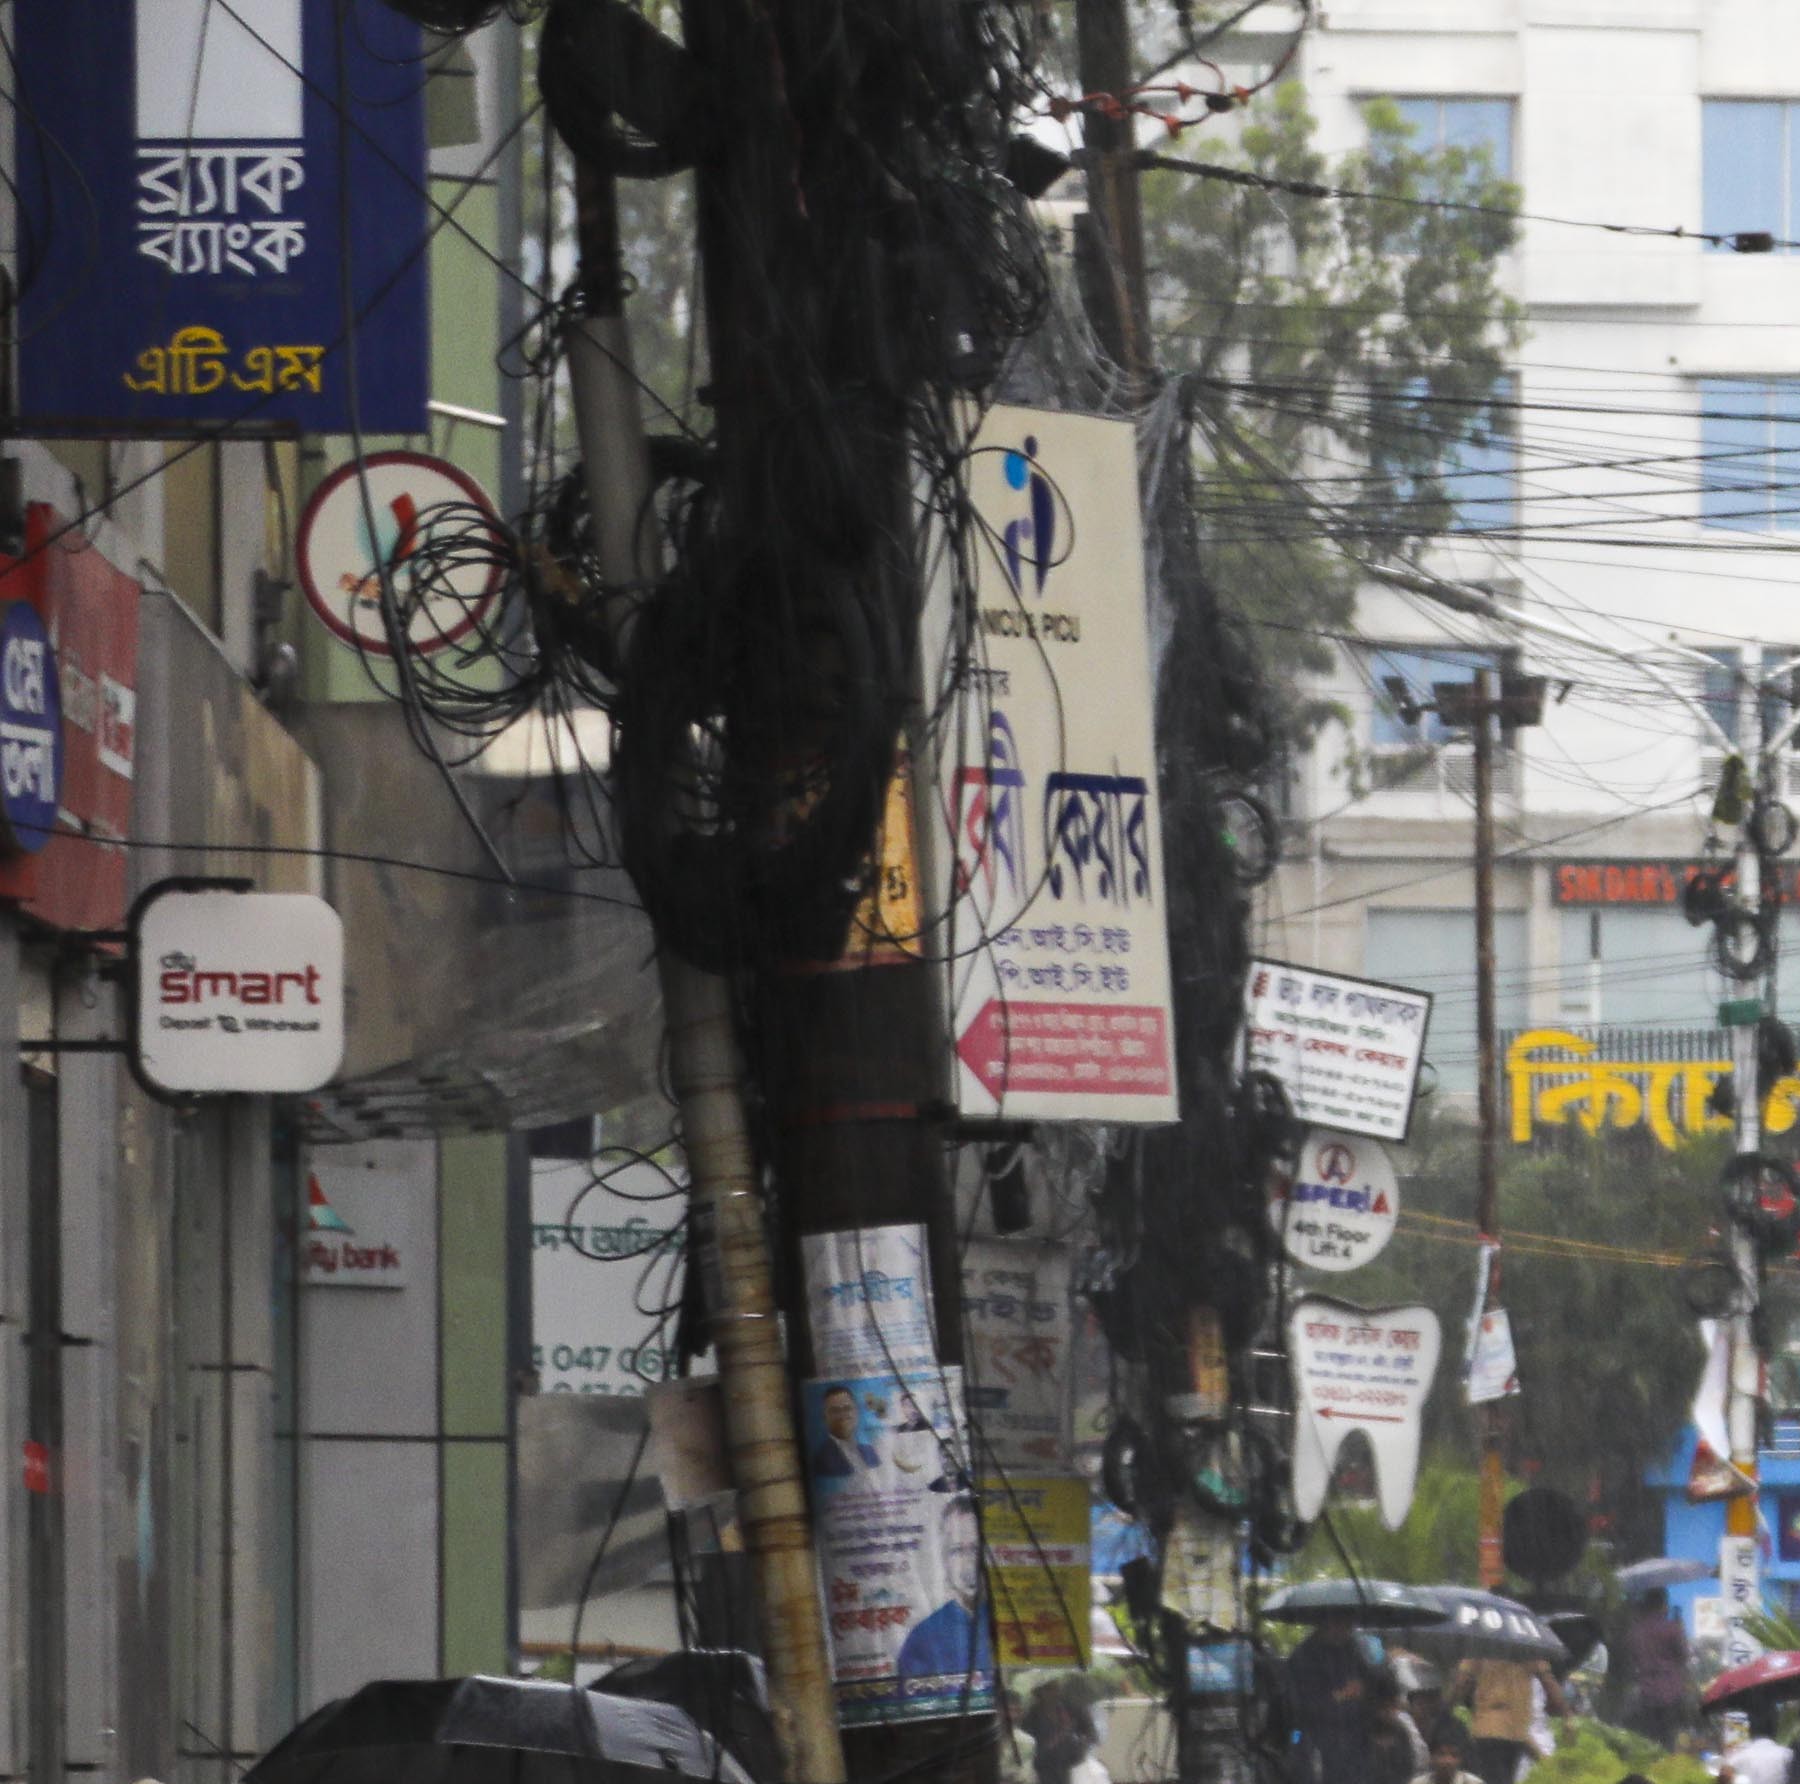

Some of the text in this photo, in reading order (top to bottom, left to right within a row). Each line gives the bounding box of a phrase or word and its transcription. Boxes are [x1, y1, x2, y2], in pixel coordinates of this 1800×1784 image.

[138, 147, 304, 216] ব্র্যাক
[138, 222, 306, 276] ব্যাংক
[1043, 768, 1154, 908] কেয়ার
[160, 964, 321, 1005] smart
[309, 1240, 401, 1273] ity bank
[552, 1344, 612, 1373] 047
